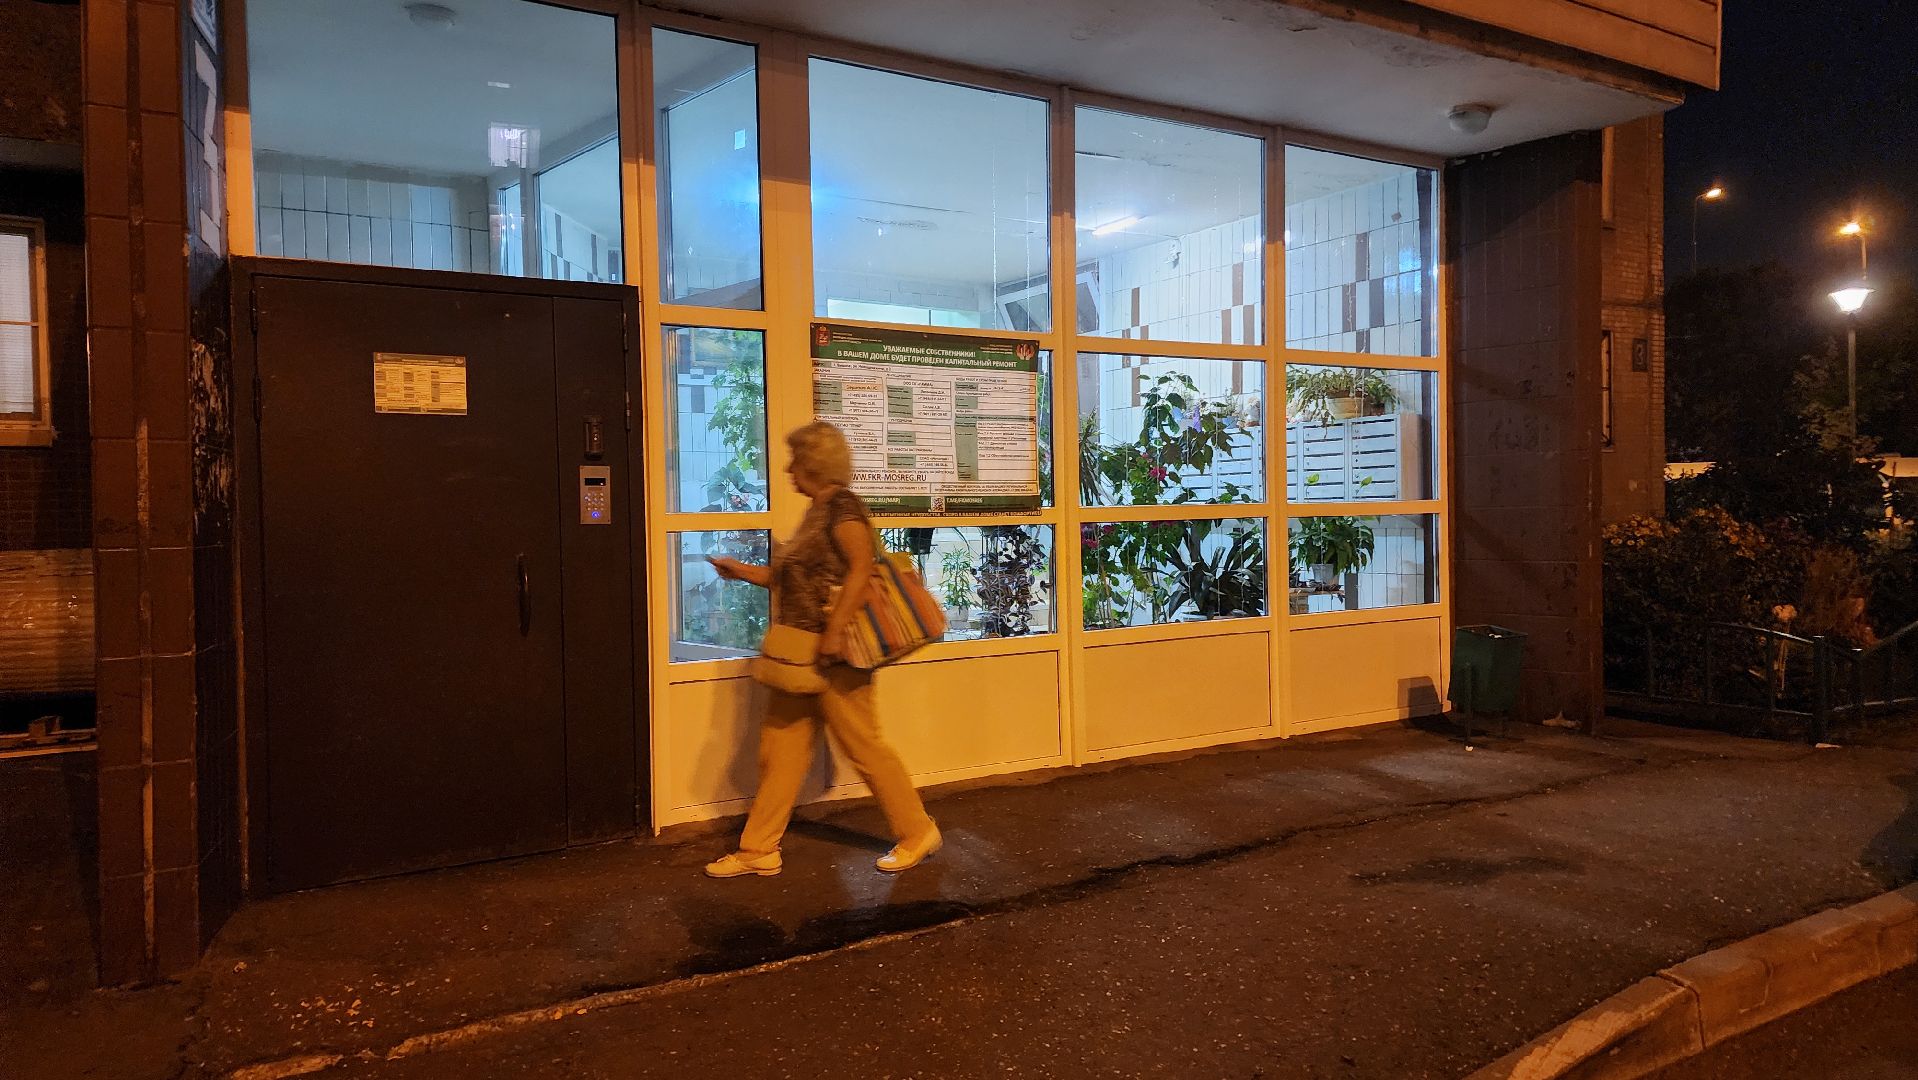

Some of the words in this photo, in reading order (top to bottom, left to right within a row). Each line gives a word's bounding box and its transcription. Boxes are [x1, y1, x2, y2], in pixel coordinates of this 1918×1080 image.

[882, 345, 925, 354] УВАЖАЕМЫЕ
[926, 348, 976, 358] СОБСТВЕННИКИ!
[843, 350, 869, 359] ВАШЕМ
[869, 352, 890, 361] ДОМЕ
[891, 354, 911, 363] БУДЕТ
[945, 358, 992, 367] КАПИТАЛЬНЫЙ
[851, 473, 927, 482] WW.FKR-MOSREG.RU
